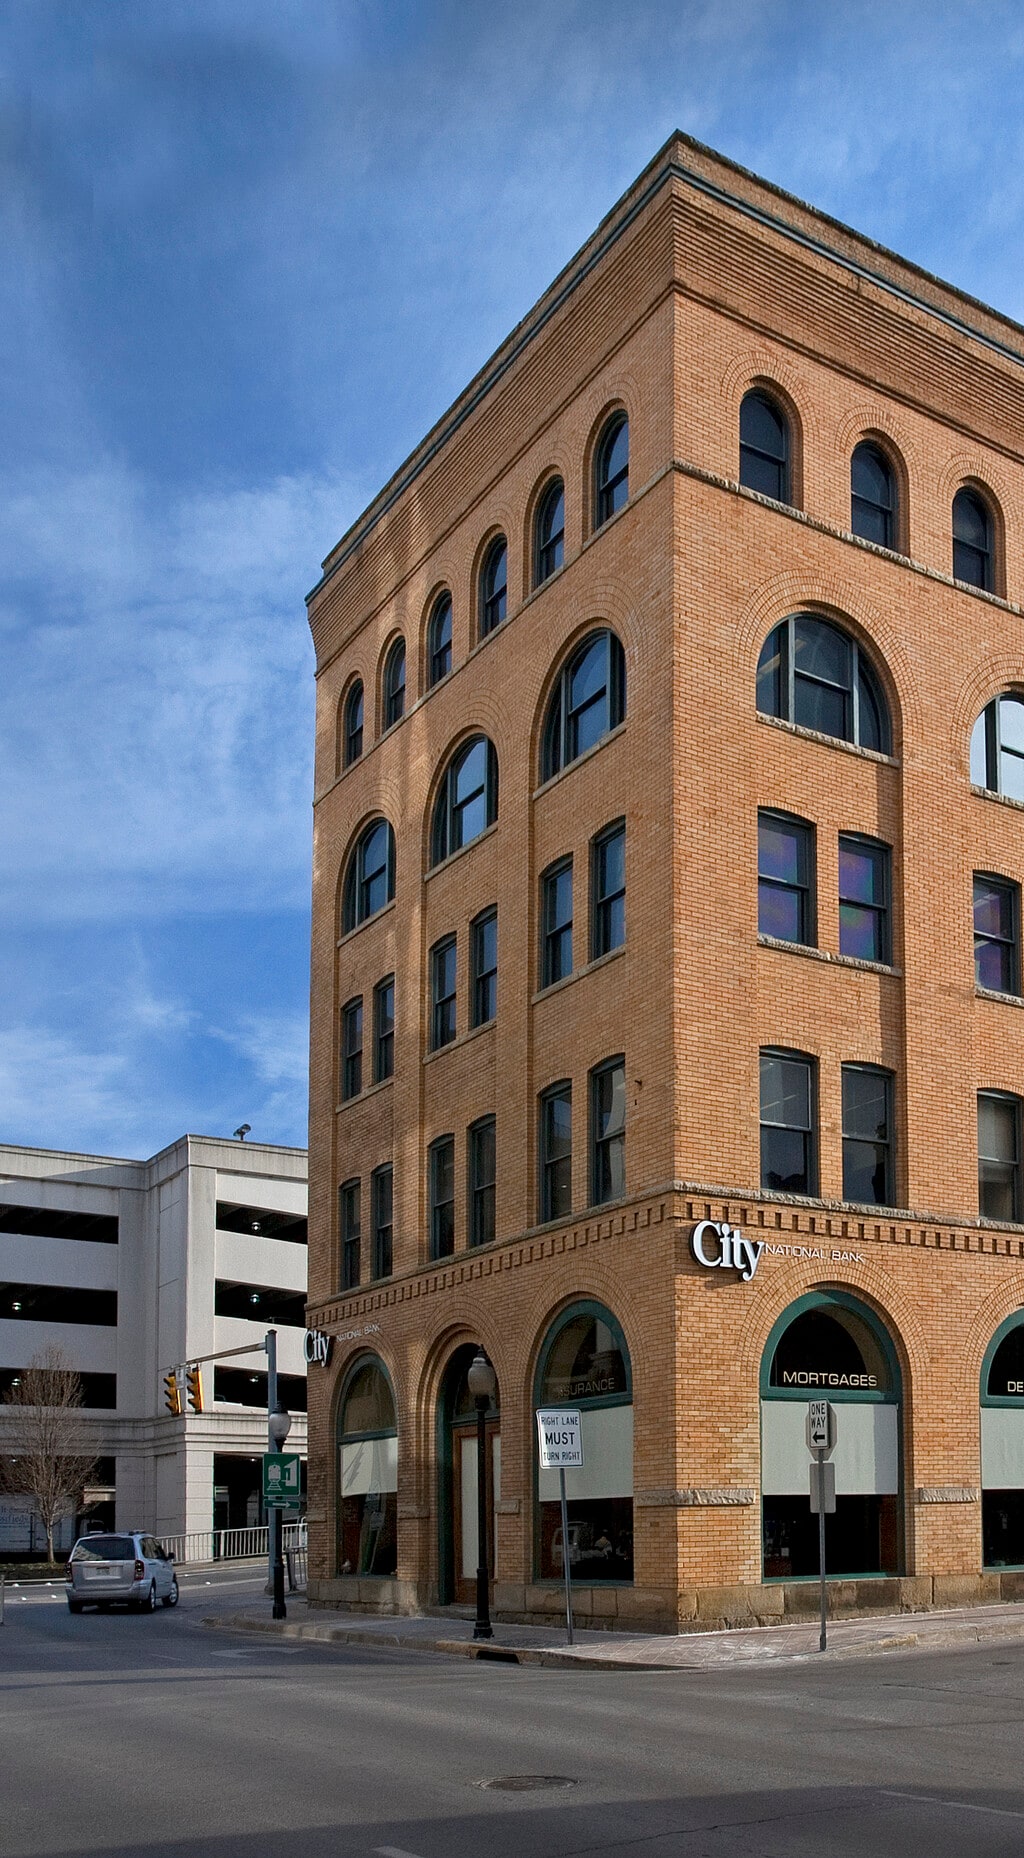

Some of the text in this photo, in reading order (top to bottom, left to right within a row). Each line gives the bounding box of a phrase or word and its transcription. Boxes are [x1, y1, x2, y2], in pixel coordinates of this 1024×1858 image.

[693, 1220, 864, 1281] City NATIONAL BANK
[304, 1323, 381, 1368] City NATIONAL BANK
[783, 1371, 878, 1387] MORTGAGES
[556, 1377, 615, 1397] NSURANCE
[811, 1403, 825, 1415] ONE
[541, 1416, 579, 1426] RIGHT LANE
[811, 1417, 825, 1429] WAY
[545, 1432, 575, 1445] MUST
[543, 1451, 581, 1461] TURN RIGHT
